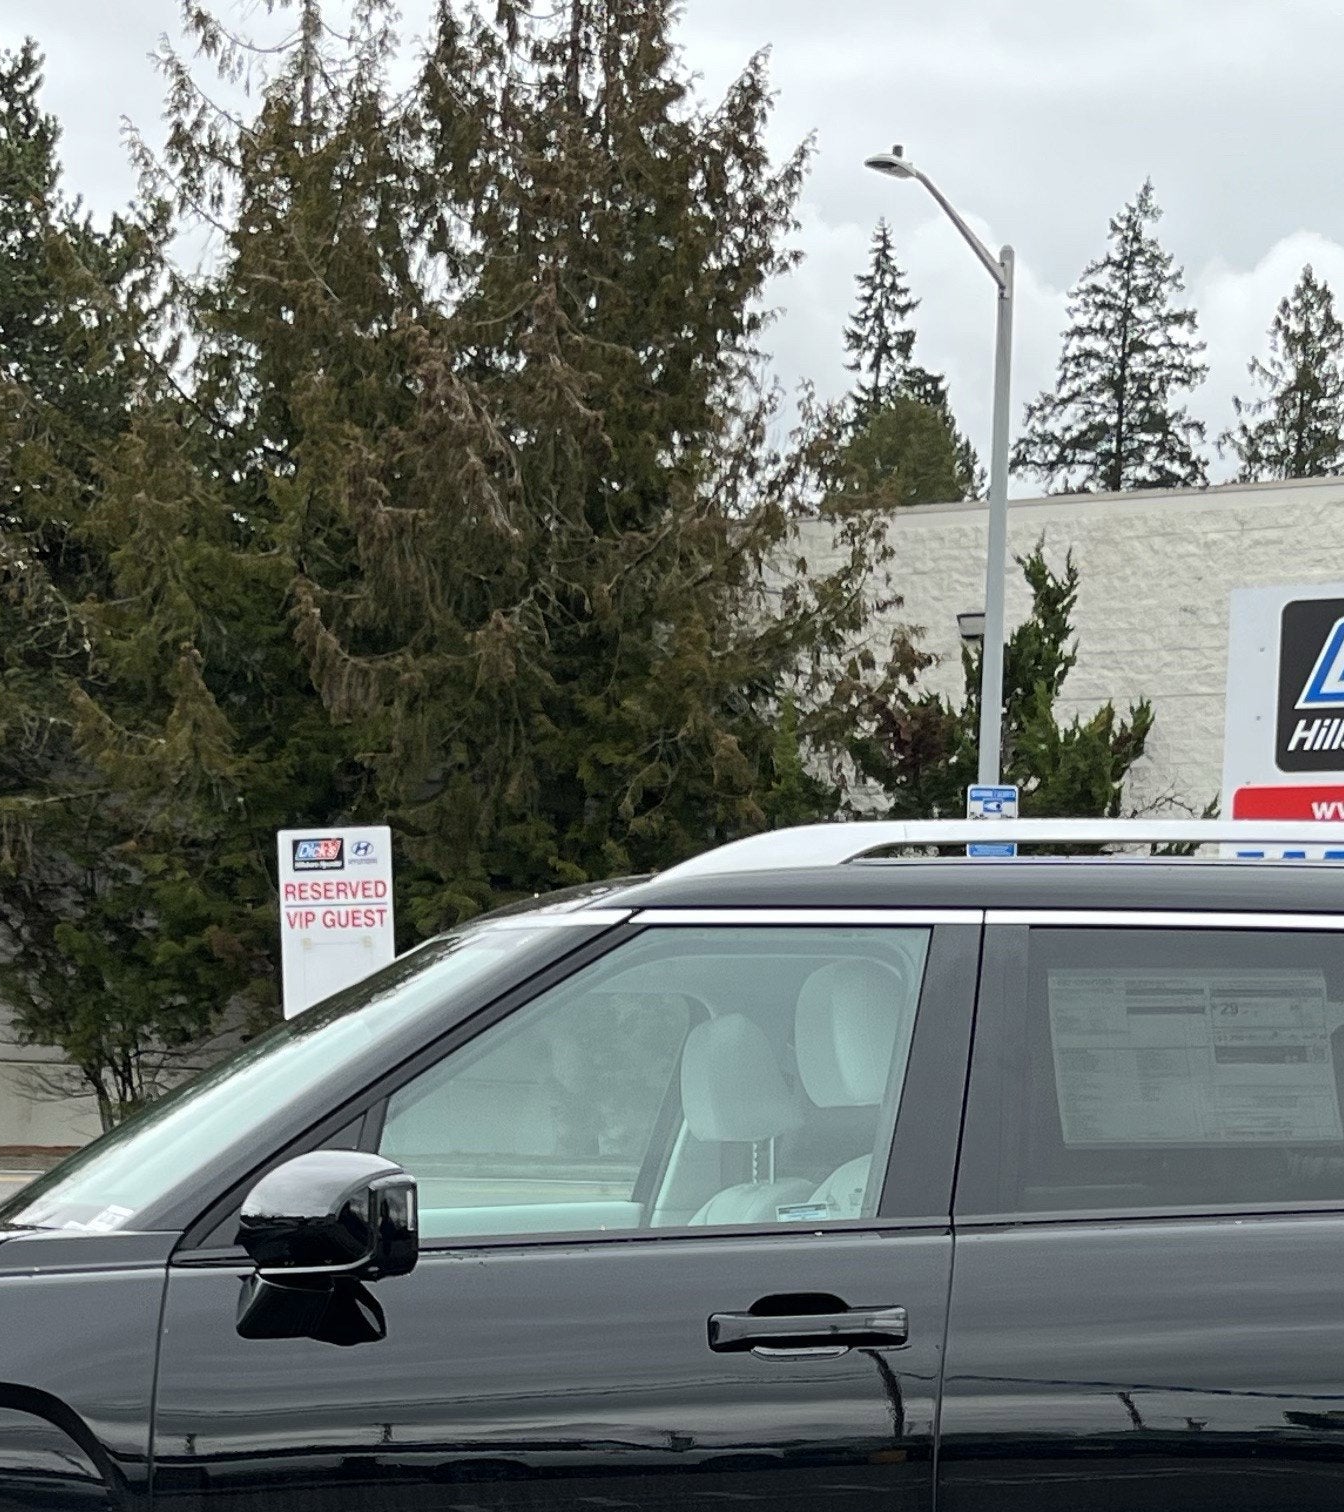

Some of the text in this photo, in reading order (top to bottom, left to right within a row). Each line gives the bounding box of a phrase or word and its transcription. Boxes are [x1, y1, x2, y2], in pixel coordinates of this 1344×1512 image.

[284, 880, 387, 902] RESERVED
[286, 909, 388, 930] VIP GUEST
